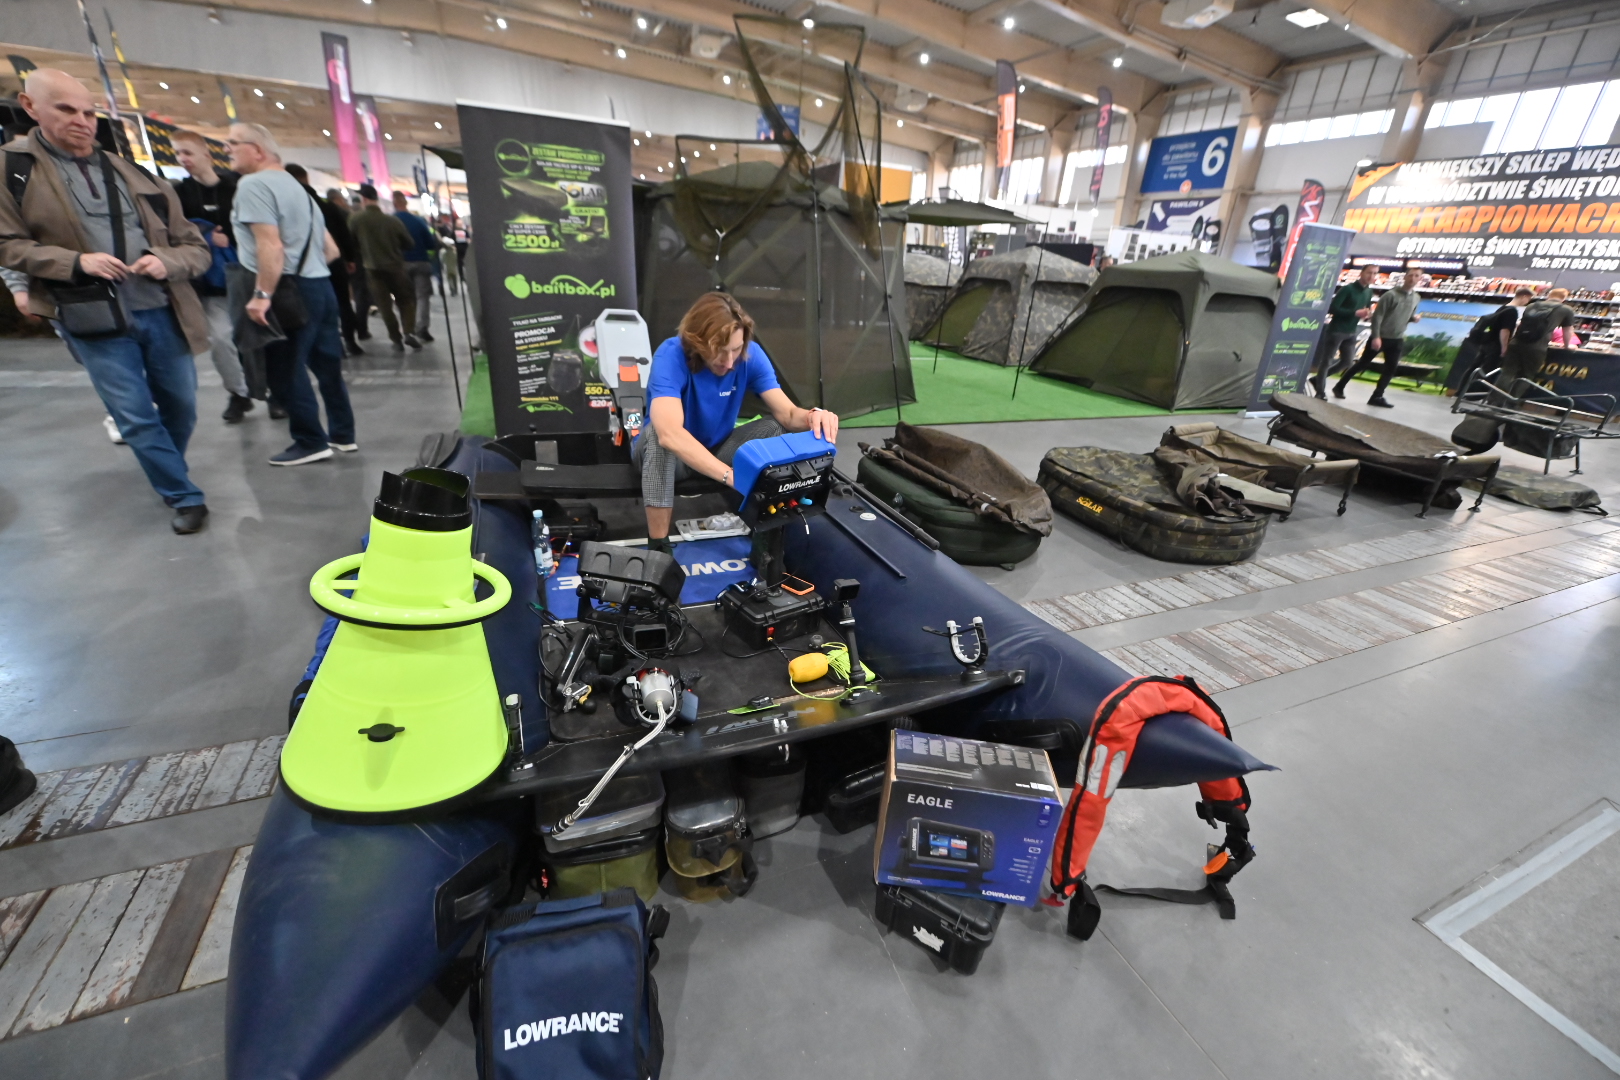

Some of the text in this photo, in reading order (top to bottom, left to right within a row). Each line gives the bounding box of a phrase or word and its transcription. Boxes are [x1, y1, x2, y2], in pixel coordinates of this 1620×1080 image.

[1202, 135, 1229, 177] 6
[1504, 151, 1572, 175] SKLEP
[1170, 200, 1198, 208] PAWILON
[1366, 186, 1388, 205] W
[504, 234, 551, 249] 2500
[1396, 237, 1485, 254] OSTROWIEC
[531, 275, 616, 299] baitbox.pl
[514, 326, 556, 339] PROMOCJA
[585, 386, 603, 395] 550
[778, 475, 822, 493] LOWRANCE
[1076, 496, 1104, 514] SOLAR
[907, 793, 954, 809] EAGLE
[982, 889, 1026, 902] LOWRANCE
[504, 1011, 623, 1051] LOWRANCE
